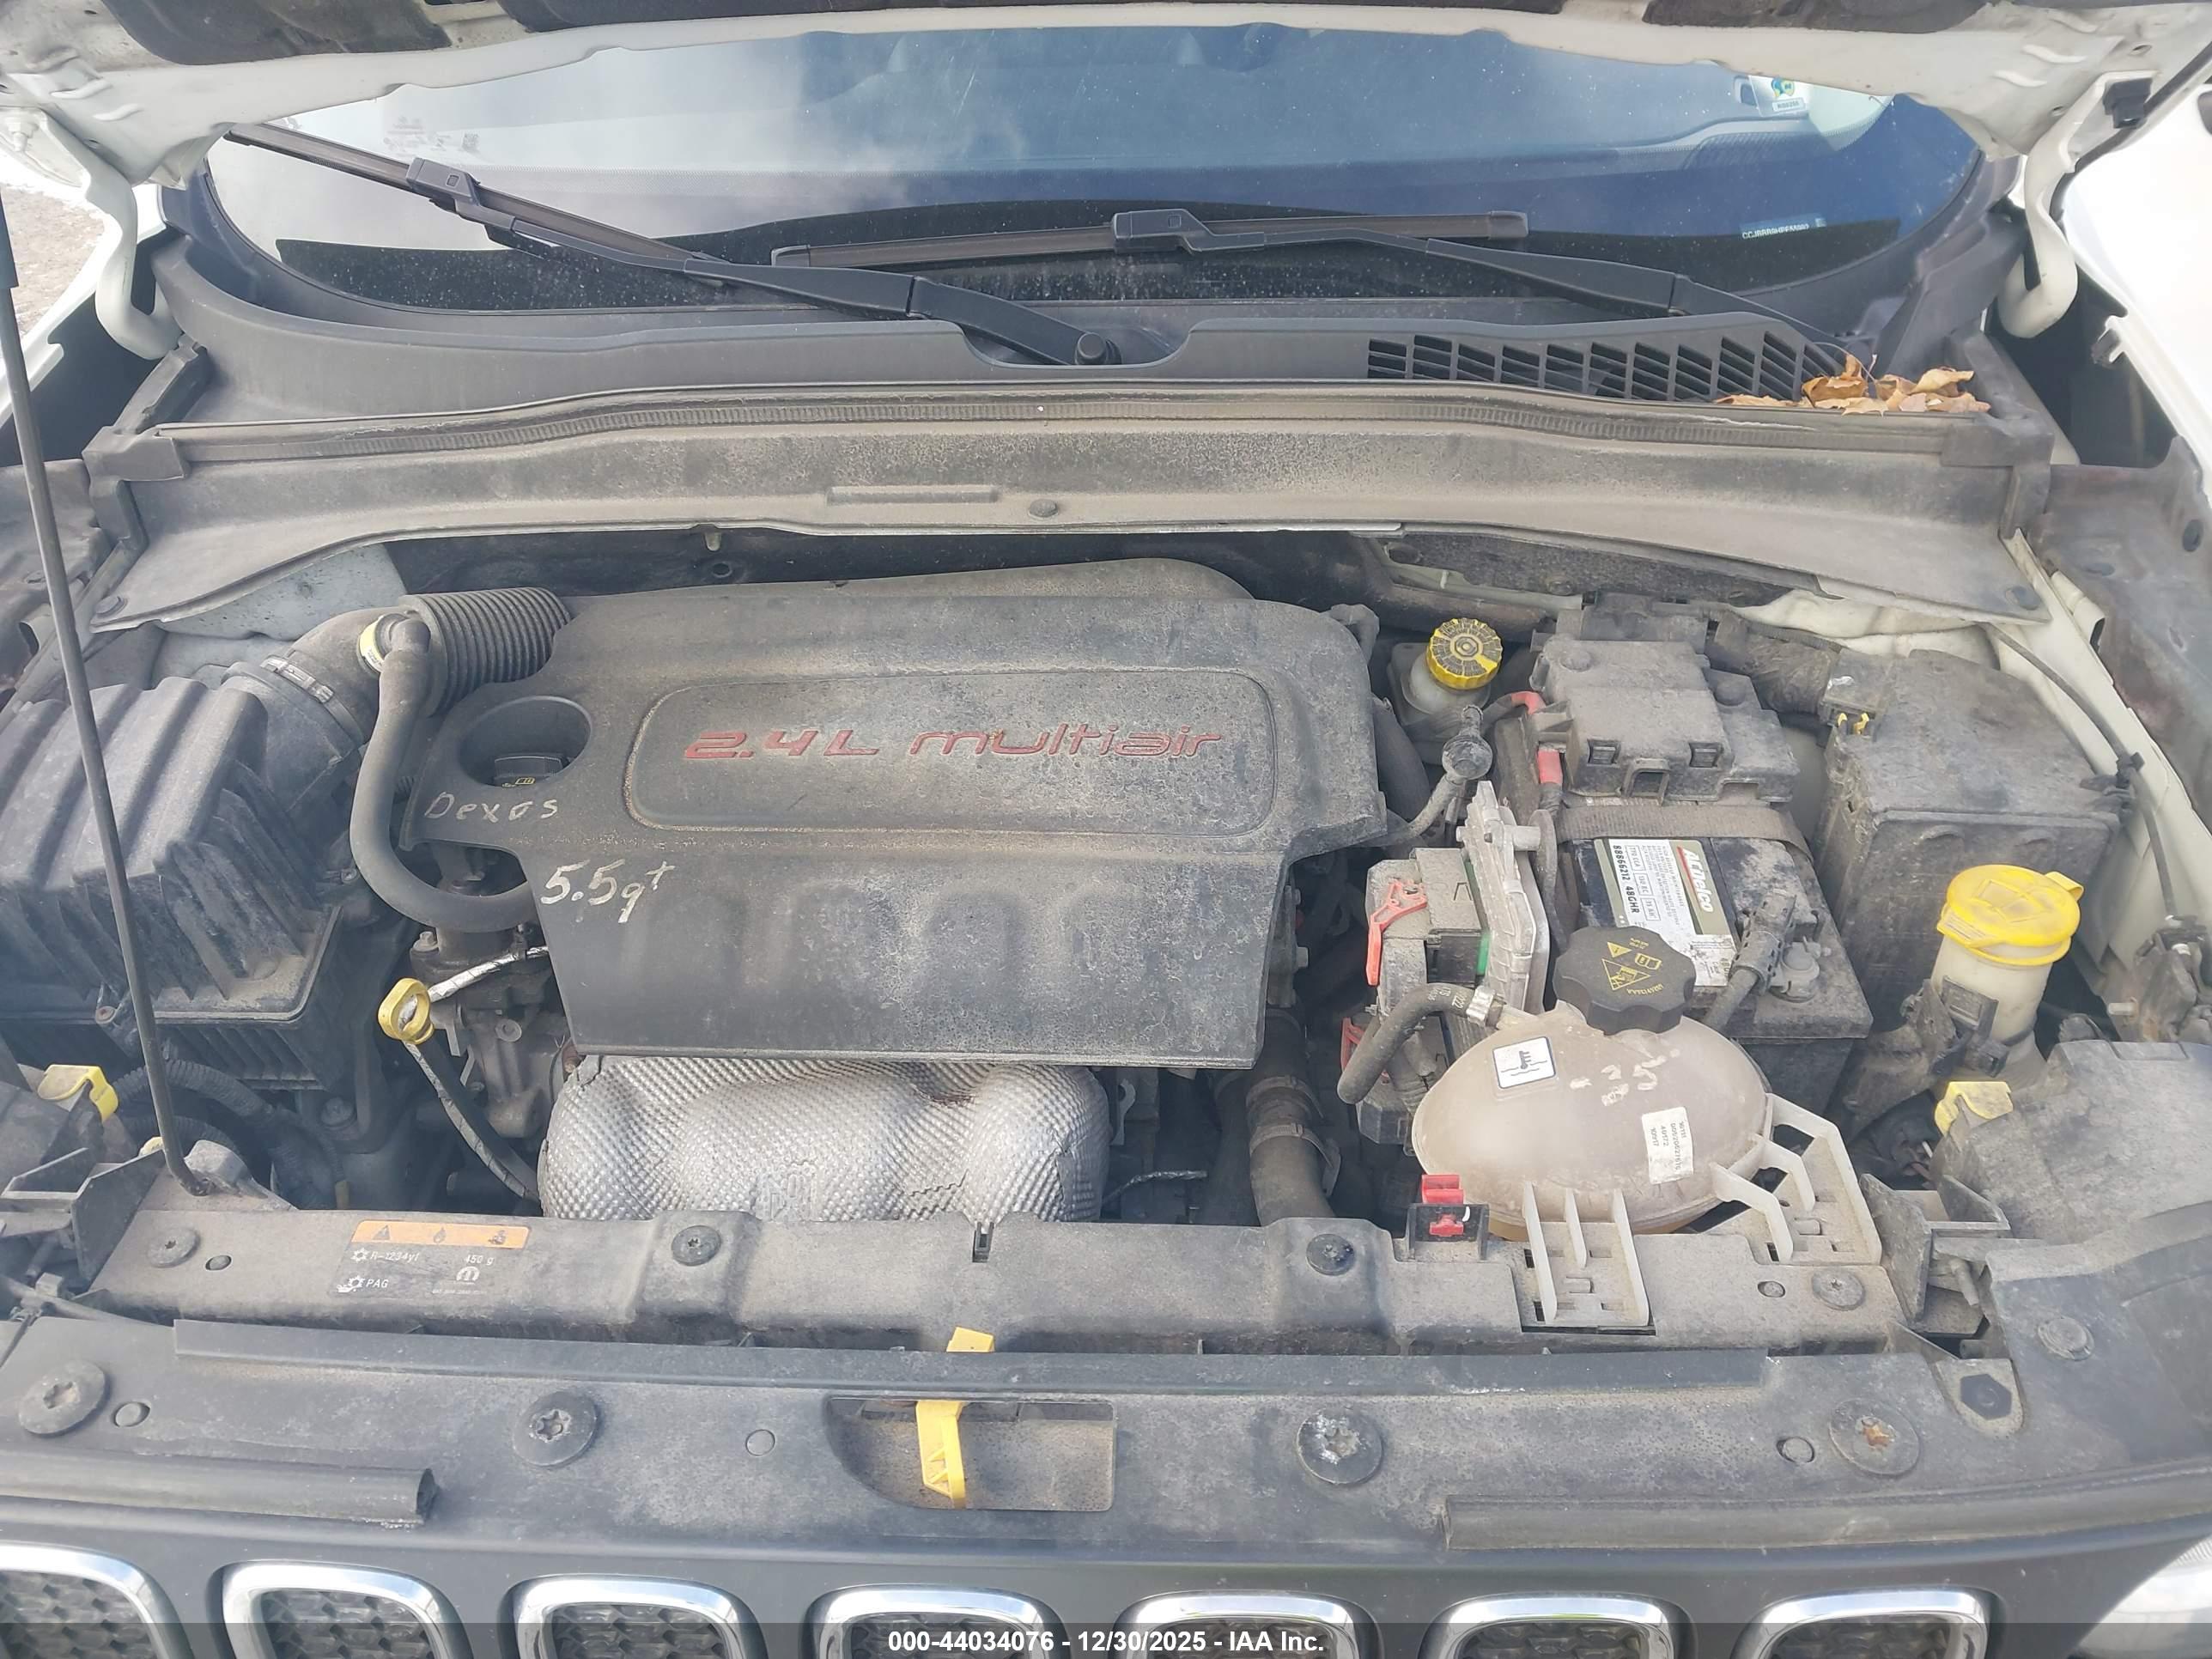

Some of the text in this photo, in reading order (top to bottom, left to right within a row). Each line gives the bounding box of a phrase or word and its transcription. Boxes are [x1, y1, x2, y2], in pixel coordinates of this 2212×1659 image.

[909, 722, 1223, 759] multiair
[423, 791, 558, 823] Dexos
[1613, 845, 1631, 881] 88866212
[1625, 886, 1640, 914] 48GHR
[1680, 847, 1715, 913] ACDelco
[366, 1279, 389, 1288] PAG
